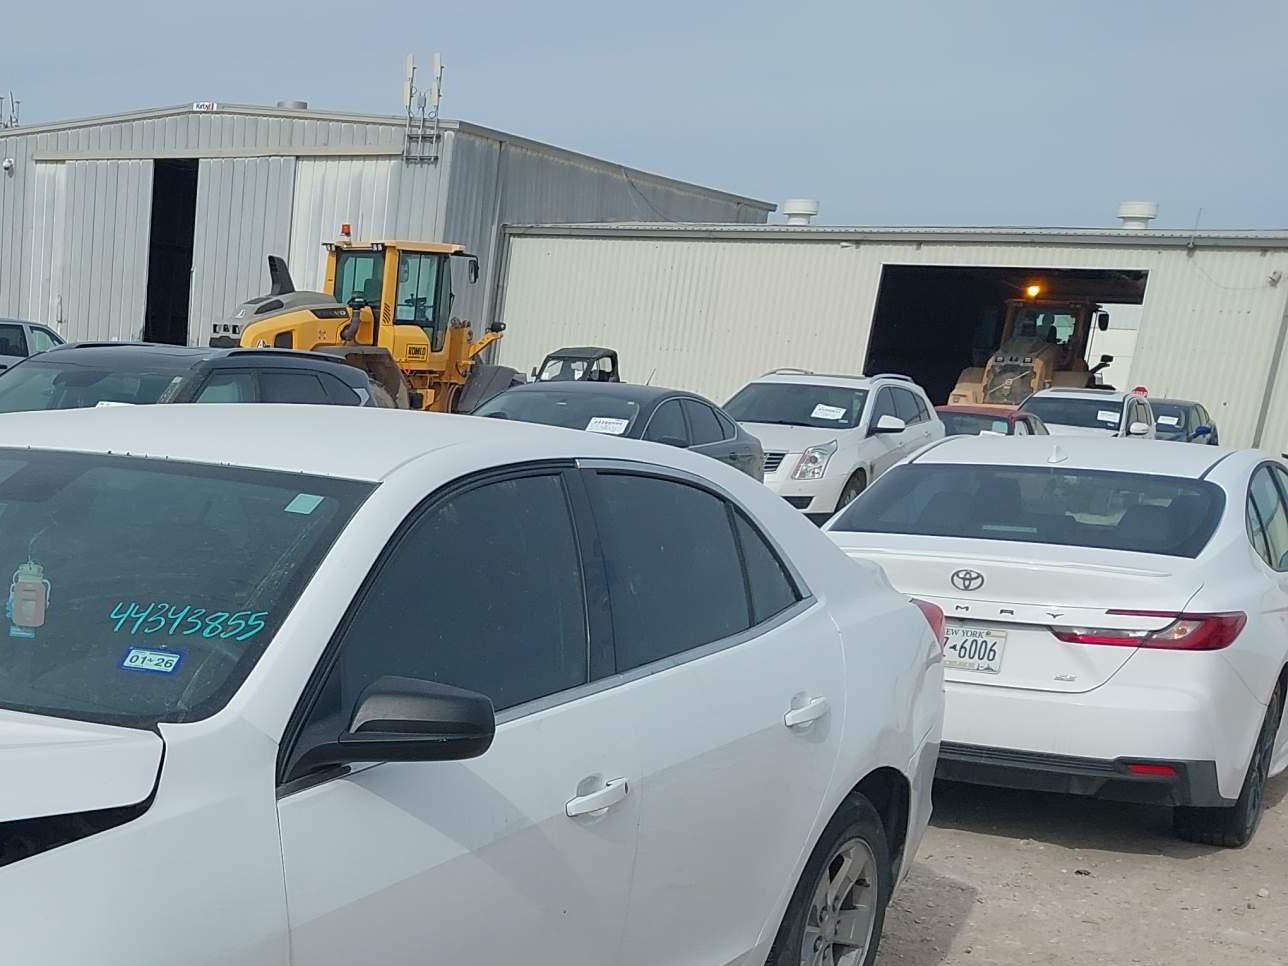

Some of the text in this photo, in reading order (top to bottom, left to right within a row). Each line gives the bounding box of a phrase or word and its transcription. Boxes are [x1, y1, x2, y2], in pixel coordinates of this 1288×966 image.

[110, 601, 269, 641] 44343855
[943, 628, 985, 639] EW YORK
